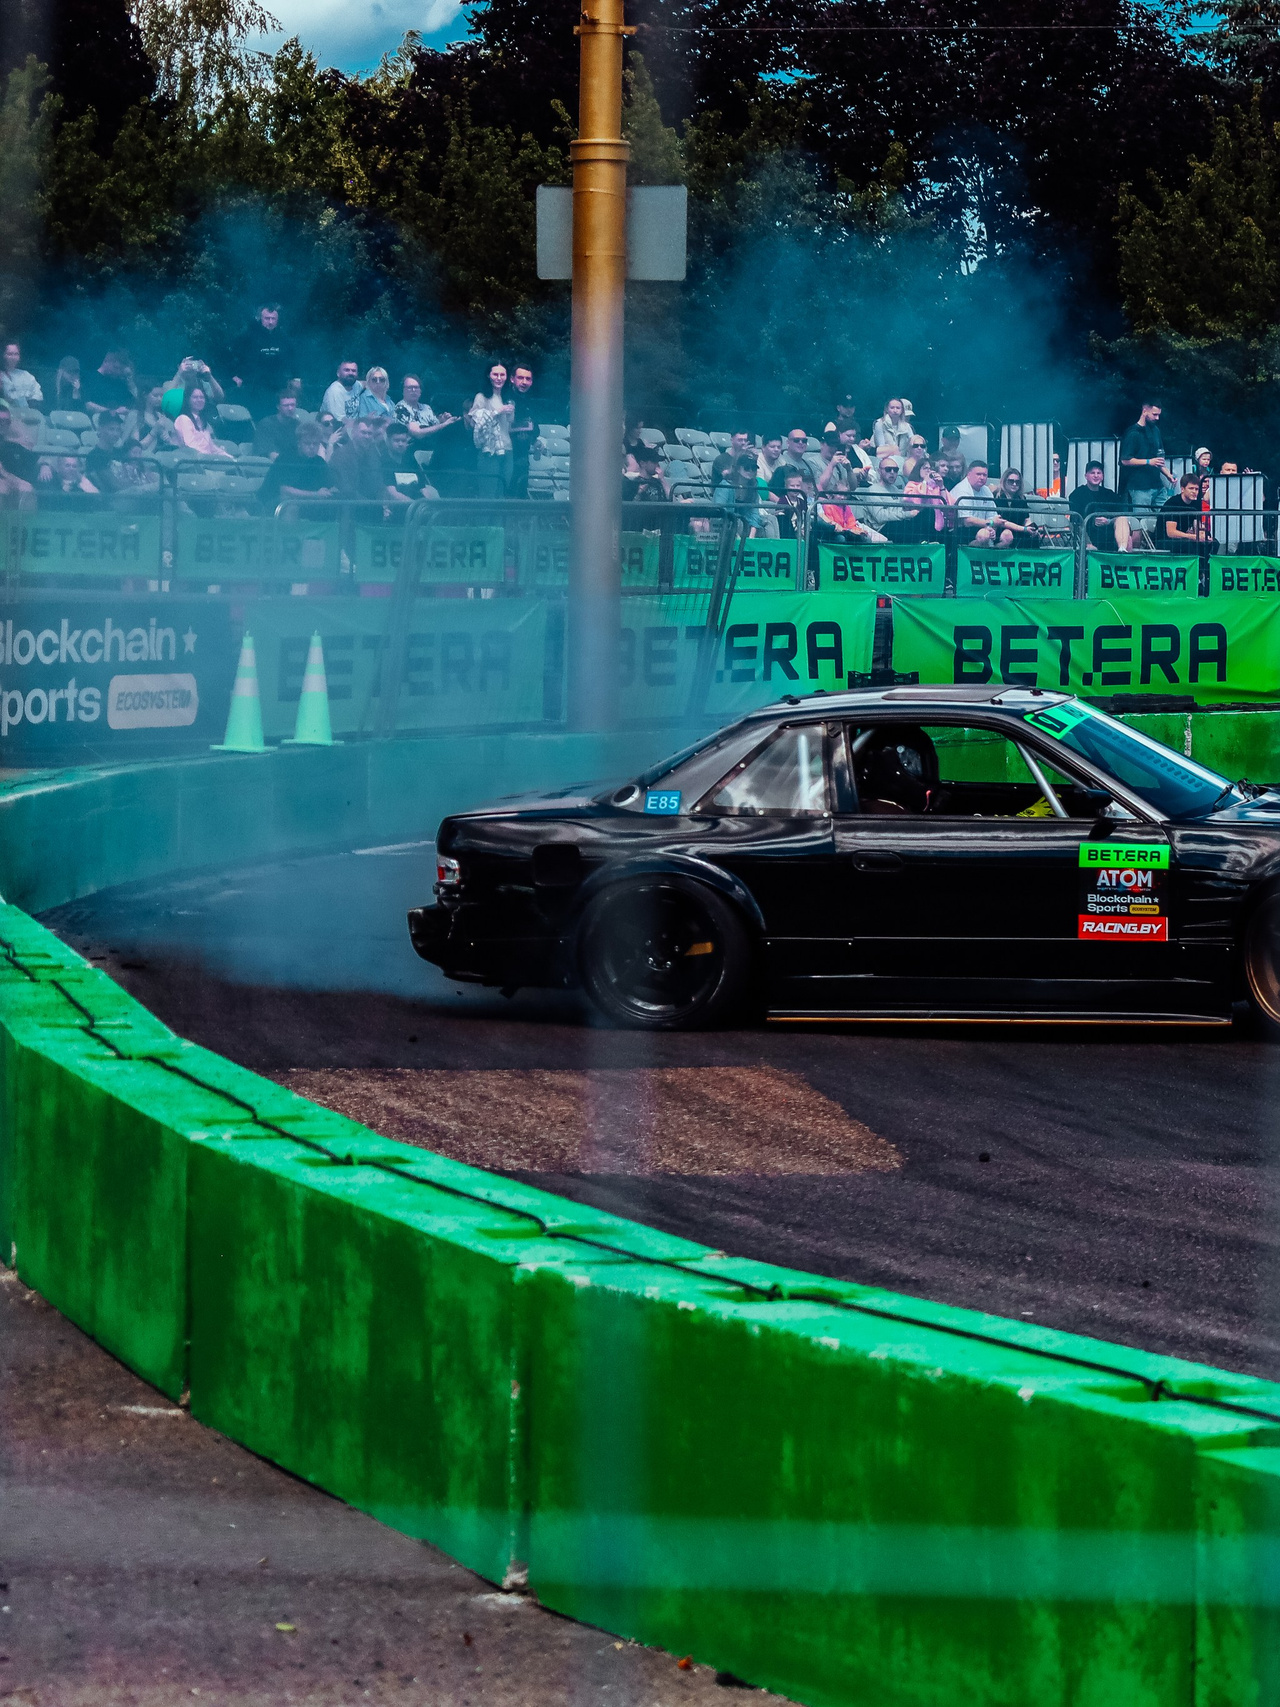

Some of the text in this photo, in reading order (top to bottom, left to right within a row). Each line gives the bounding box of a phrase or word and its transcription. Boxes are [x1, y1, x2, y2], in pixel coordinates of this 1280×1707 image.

[195, 533, 322, 564] BET.ER
[371, 540, 487, 568] BE.ERA
[688, 549, 790, 578] BE.ERA
[833, 556, 933, 583] BET.ERA
[970, 560, 1062, 588] BET.ERA
[1101, 564, 1187, 592] BET.ERA
[0, 617, 176, 665] lockchain
[954, 622, 1228, 686] BET.ERA
[0, 677, 101, 736] ports
[647, 796, 678, 809] E85
[1087, 849, 1161, 862] BET.ERA
[1096, 869, 1153, 888] ATOM
[1087, 893, 1152, 904] Blockchain
[1087, 903, 1128, 913] Sports
[1082, 921, 1163, 934] RACING.BY
